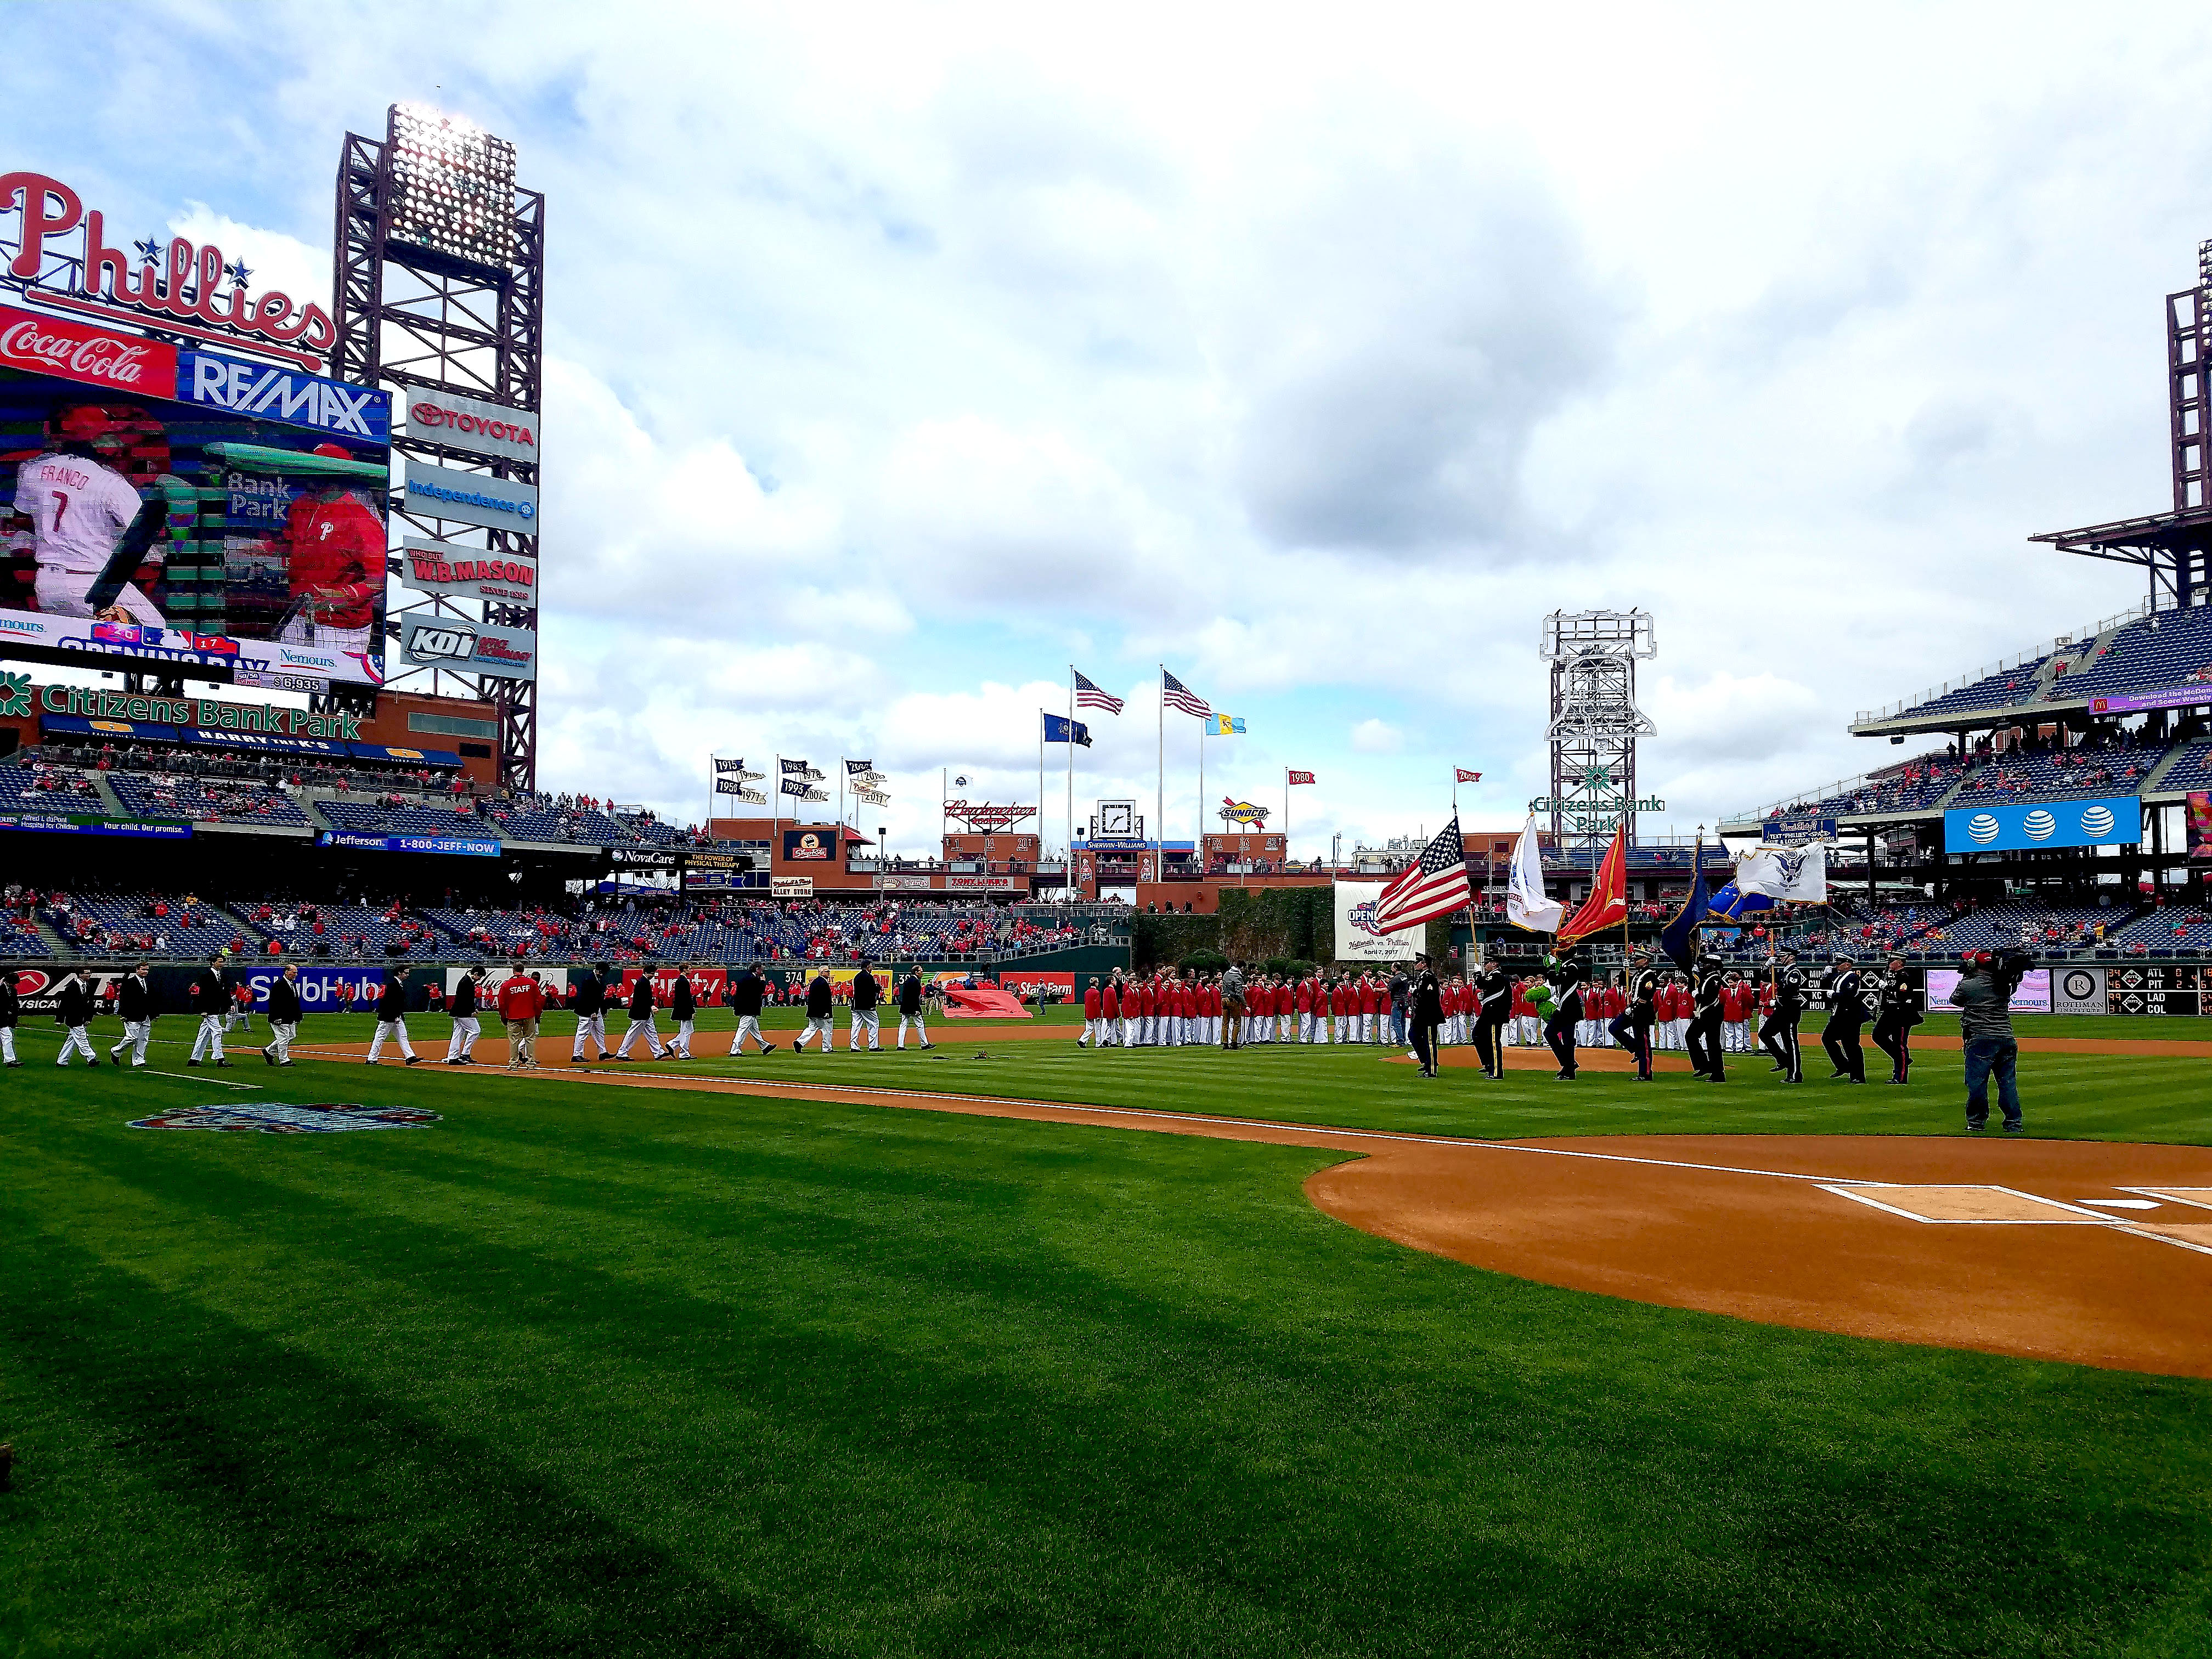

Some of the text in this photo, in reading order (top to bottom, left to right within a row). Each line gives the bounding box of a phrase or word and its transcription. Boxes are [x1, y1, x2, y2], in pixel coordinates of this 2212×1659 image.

[0, 171, 337, 350] Phillies
[1, 321, 150, 384] Coca-Cola
[194, 356, 373, 436] RE/MAX
[444, 411, 534, 446] TOYOTA
[41, 465, 89, 490] FRANCO
[228, 472, 290, 499] Bank
[408, 480, 515, 514] Independence
[52, 490, 68, 532] 7
[232, 494, 287, 521] Park
[409, 550, 426, 558] WHO
[479, 585, 508, 597] SINCE
[280, 648, 336, 667] Nemours
[235, 679, 261, 687] DRAWING
[283, 677, 320, 691] 6,935
[41, 684, 362, 741] Citizens Bank Park
[198, 730, 269, 744] HARRY
[270, 738, 297, 747] THE
[300, 740, 330, 750] K'S
[718, 761, 737, 770] 1915
[783, 761, 804, 771] 1983
[1291, 772, 1310, 782] 1980
[785, 781, 804, 794] 1993
[742, 790, 760, 802] 1977
[804, 791, 823, 800] 2007
[1534, 795, 1662, 812] Citizens Bank
[103, 822, 119, 830] Your
[155, 825, 184, 833] promise.
[1577, 816, 1618, 832] Park
[1780, 821, 1818, 832] Need Help?
[335, 834, 382, 847] Jefferson
[1017, 838, 1028, 848] 20
[1087, 841, 1146, 849] SHERWIN-WILLIAMS
[1266, 837, 1277, 847] 42
[399, 839, 495, 854] 1-800-JEFF-NOW
[624, 850, 675, 864] NovaCare
[952, 878, 976, 886] TONY
[1386, 938, 1409, 946] Phillies
[785, 972, 802, 983] 374
[2147, 968, 2165, 977] ATL
[509, 985, 531, 994] STAFF
[1047, 981, 1073, 995] Farm
[2074, 979, 2087, 990] R
[2108, 980, 2120, 989] 46
[2148, 980, 2163, 989] PIT
[2176, 980, 2182, 989] 2
[1812, 991, 1822, 1000] KC
[2109, 993, 2121, 1001] 99
[2147, 993, 2165, 1002] LAD
[1809, 1001, 1825, 1009] HOU
[2147, 1005, 2166, 1014] COL
